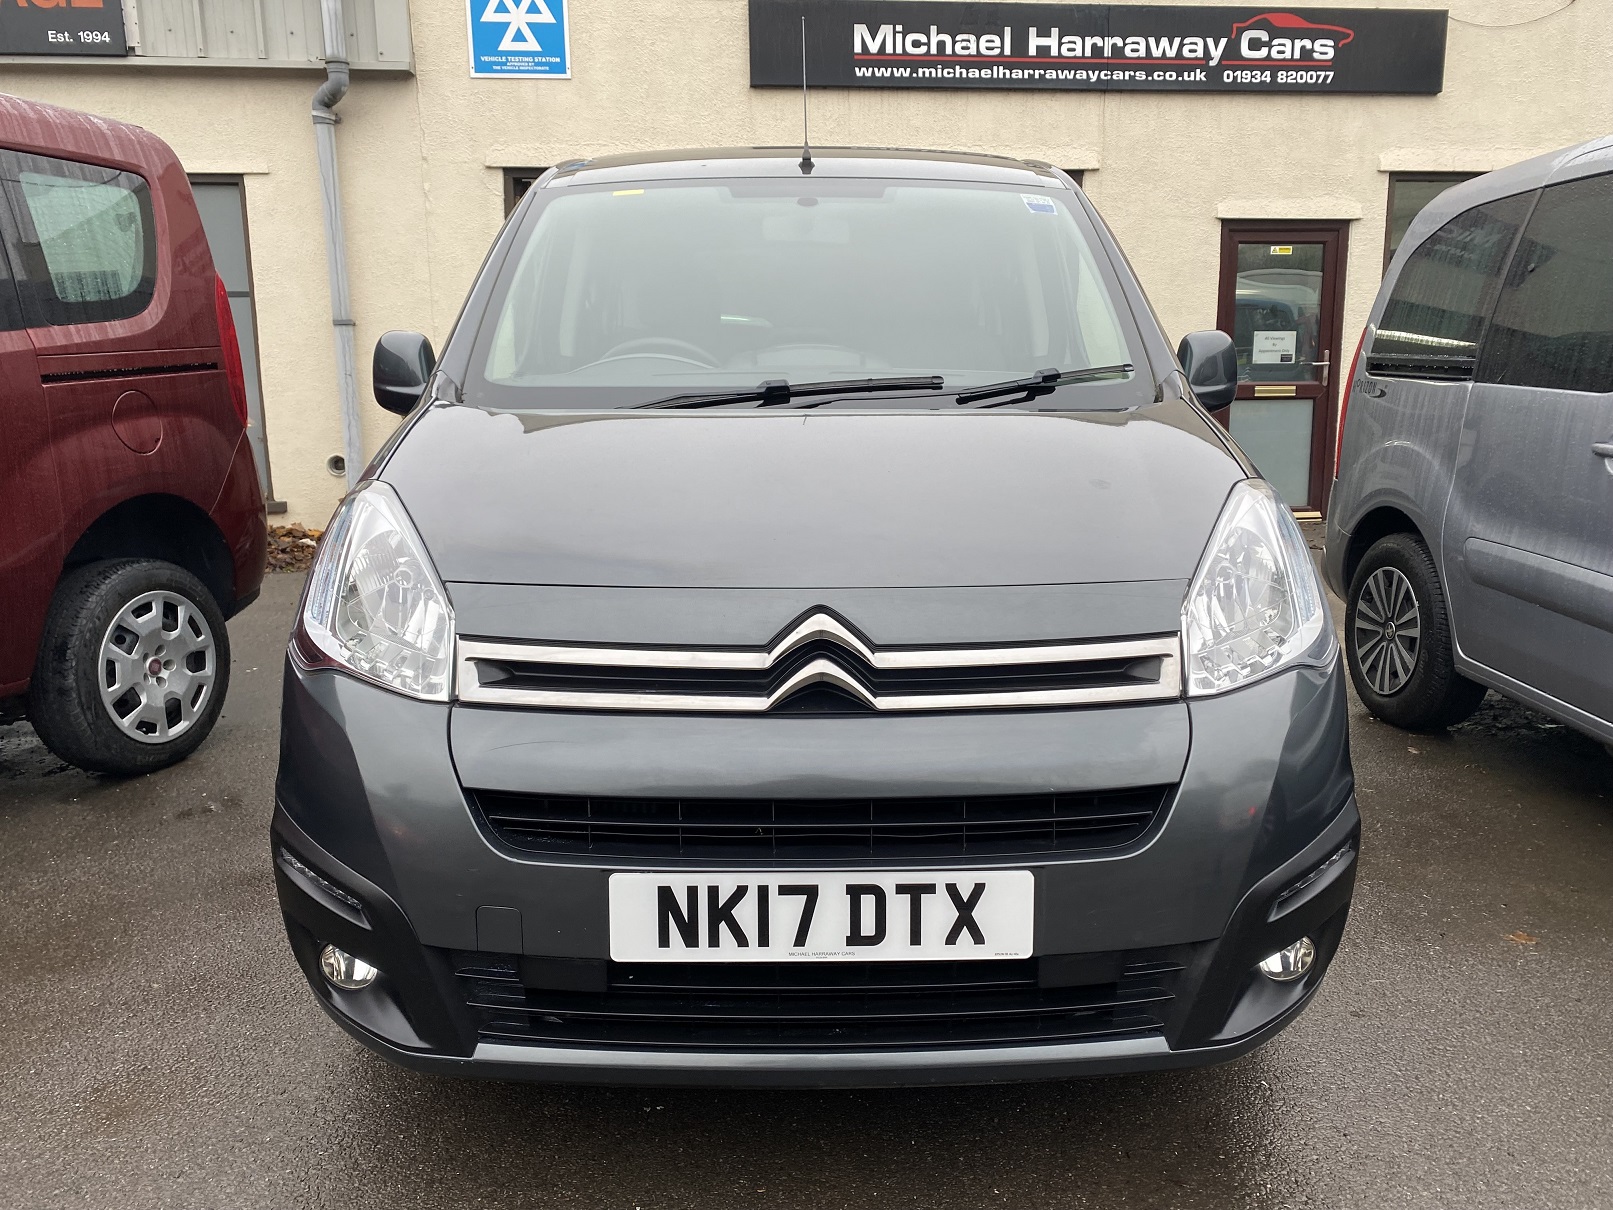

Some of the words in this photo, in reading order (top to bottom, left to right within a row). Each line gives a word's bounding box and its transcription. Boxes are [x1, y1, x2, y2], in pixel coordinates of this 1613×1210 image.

[47, 30, 74, 42] Est.
[77, 31, 111, 43] 1994
[853, 23, 1012, 55] Michael
[1028, 26, 1228, 66] Harraway
[1240, 29, 1335, 60] Cars
[854, 64, 1207, 82] www.michaelharrawaycars.co.uk
[1223, 70, 1272, 83] 01934
[1277, 71, 1335, 84] 820077
[656, 884, 820, 949] NK17
[845, 882, 987, 947] DTX
